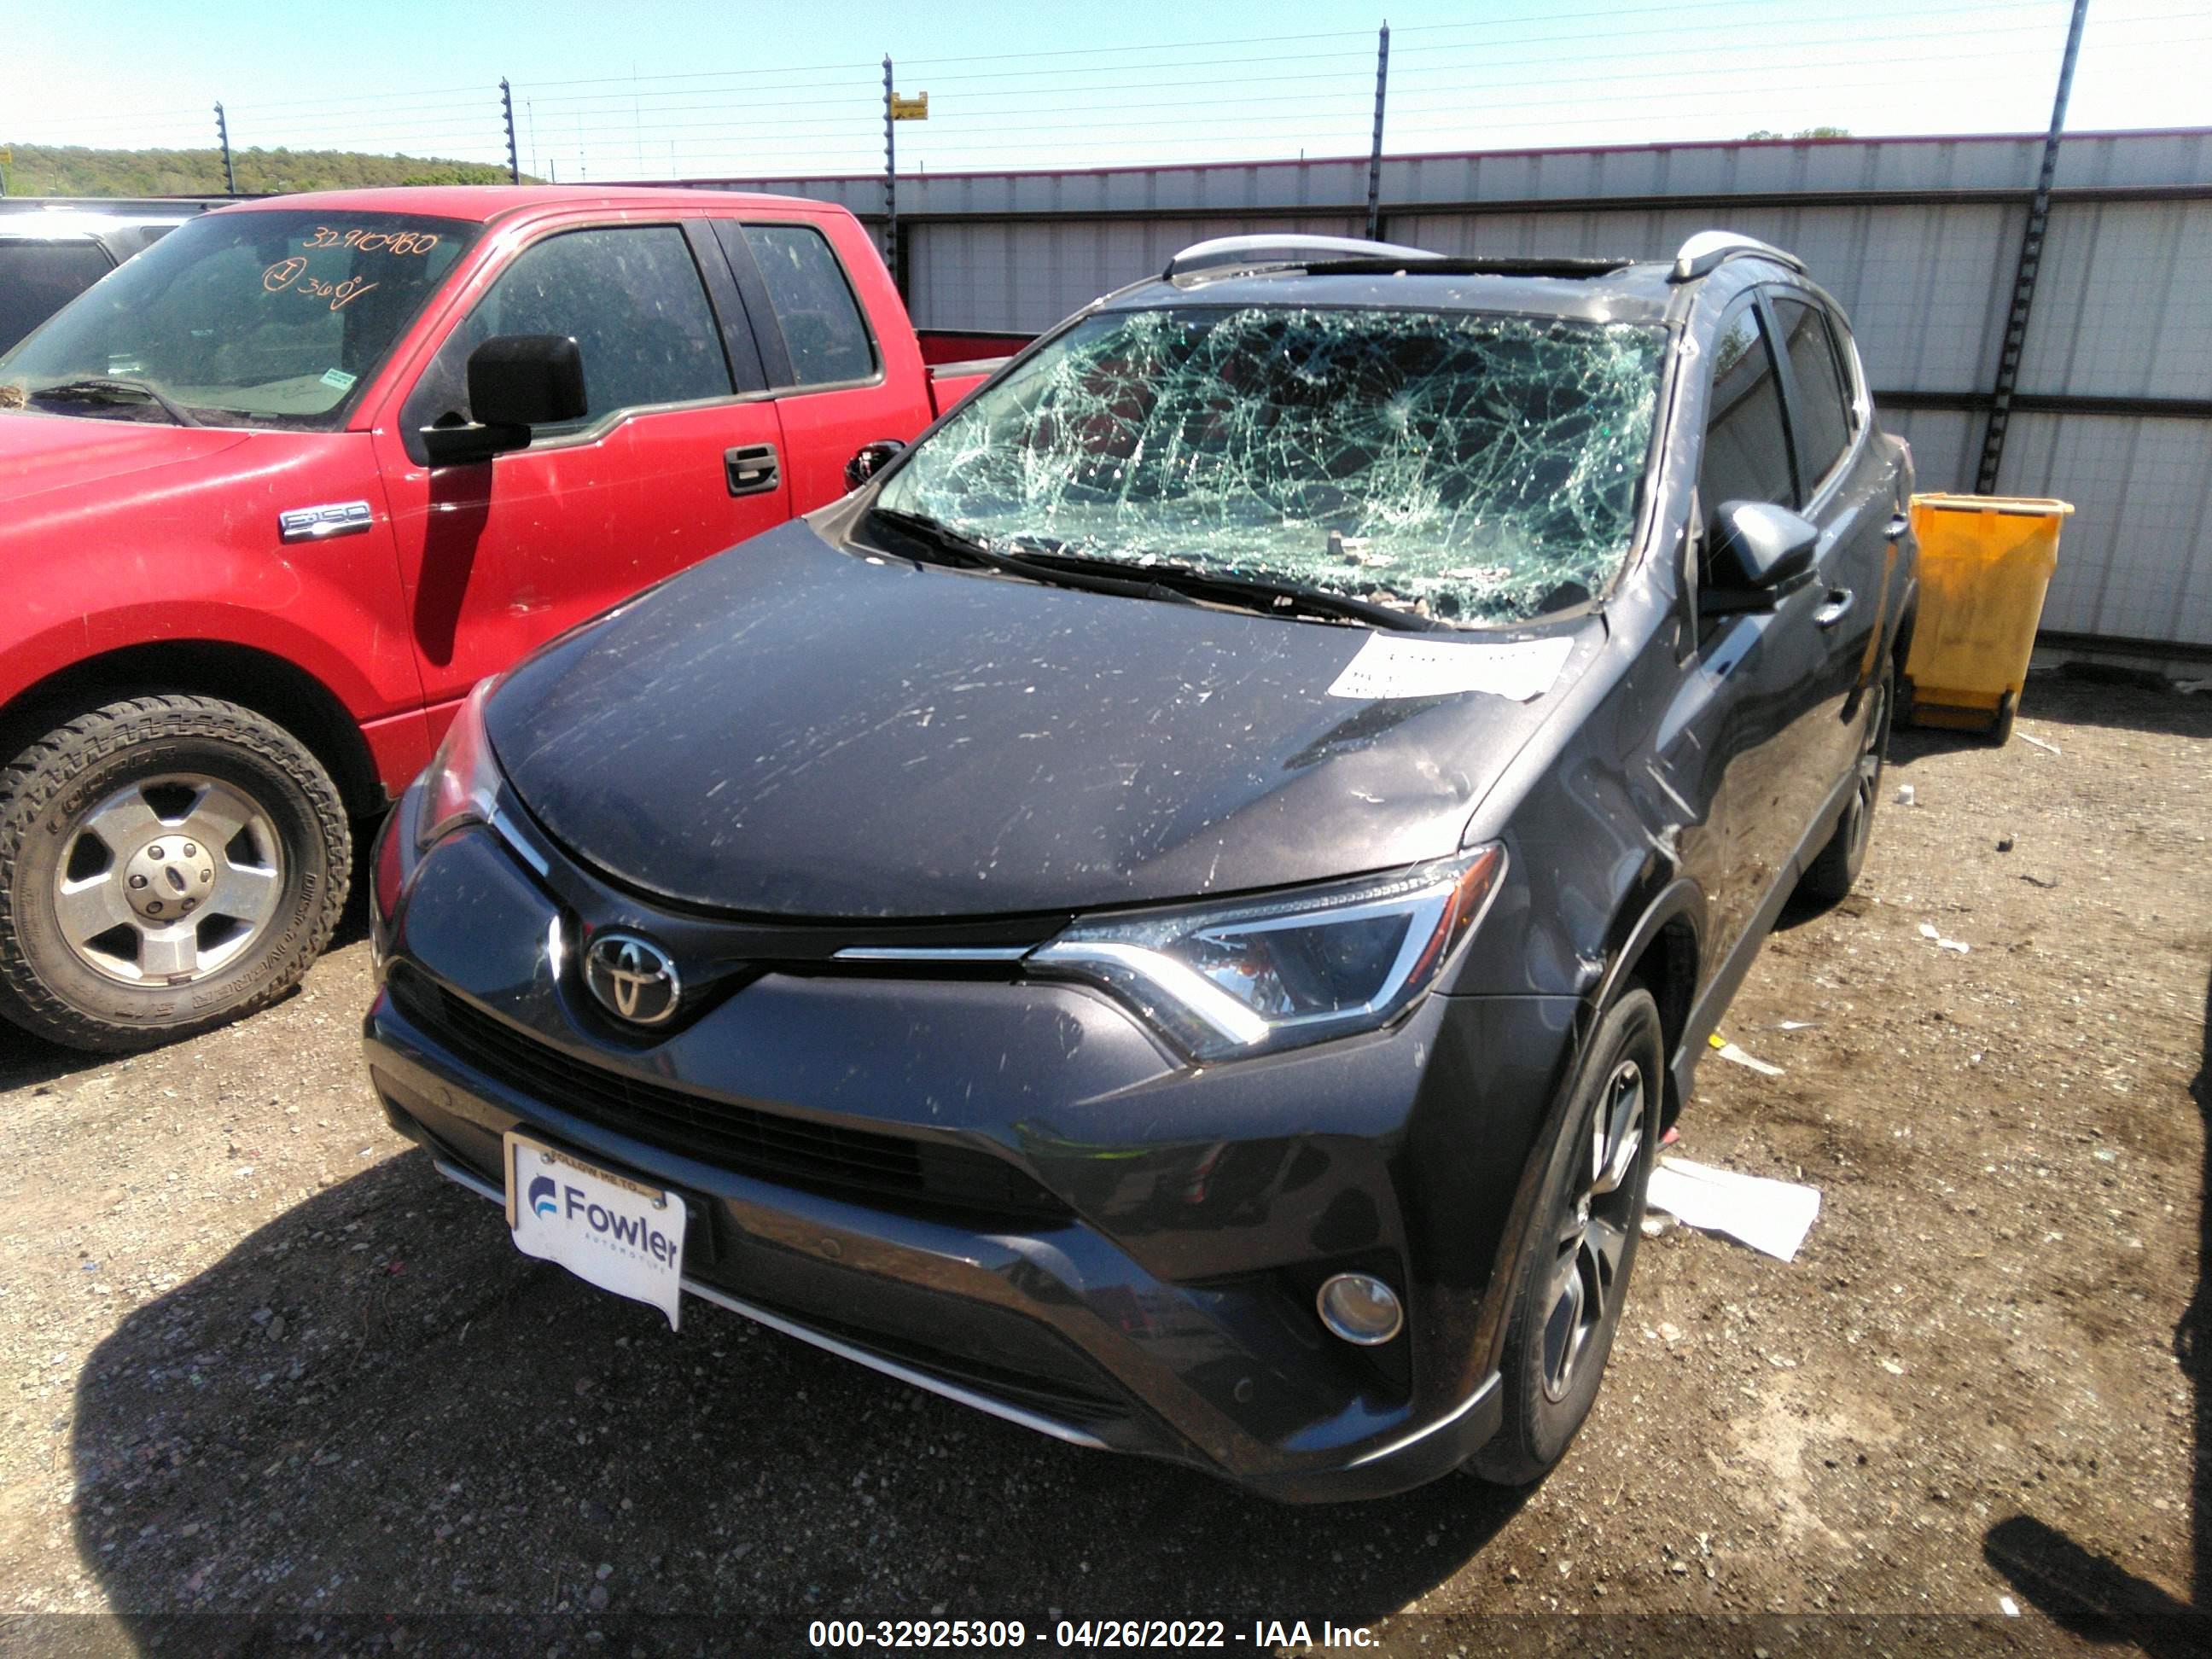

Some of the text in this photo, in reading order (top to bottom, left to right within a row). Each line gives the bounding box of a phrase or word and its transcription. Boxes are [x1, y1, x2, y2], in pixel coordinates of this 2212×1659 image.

[302, 226, 439, 254] 32910980
[550, 1150, 597, 1179] FOLLOW
[600, 1172, 619, 1185] ME
[563, 1185, 678, 1269] Fowler
